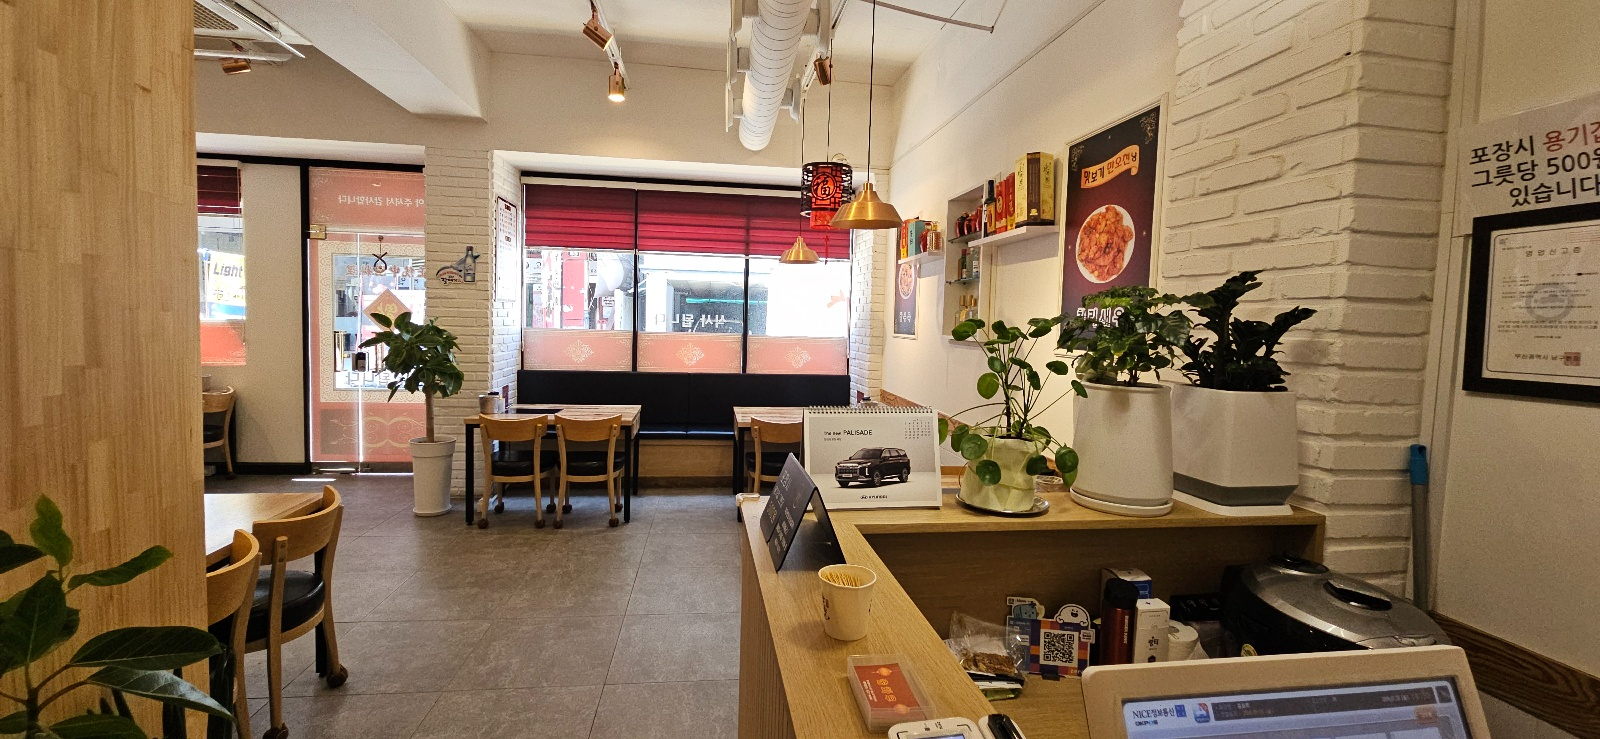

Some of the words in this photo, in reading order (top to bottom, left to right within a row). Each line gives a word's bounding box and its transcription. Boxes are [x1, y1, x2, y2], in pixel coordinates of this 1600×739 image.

[1469, 135, 1534, 165] 포장시
[1083, 165, 1105, 184] 맛보기
[1471, 160, 1538, 187] 그릇당
[213, 262, 243, 278] Light
[1132, 707, 1175, 719] NICE정보통신
